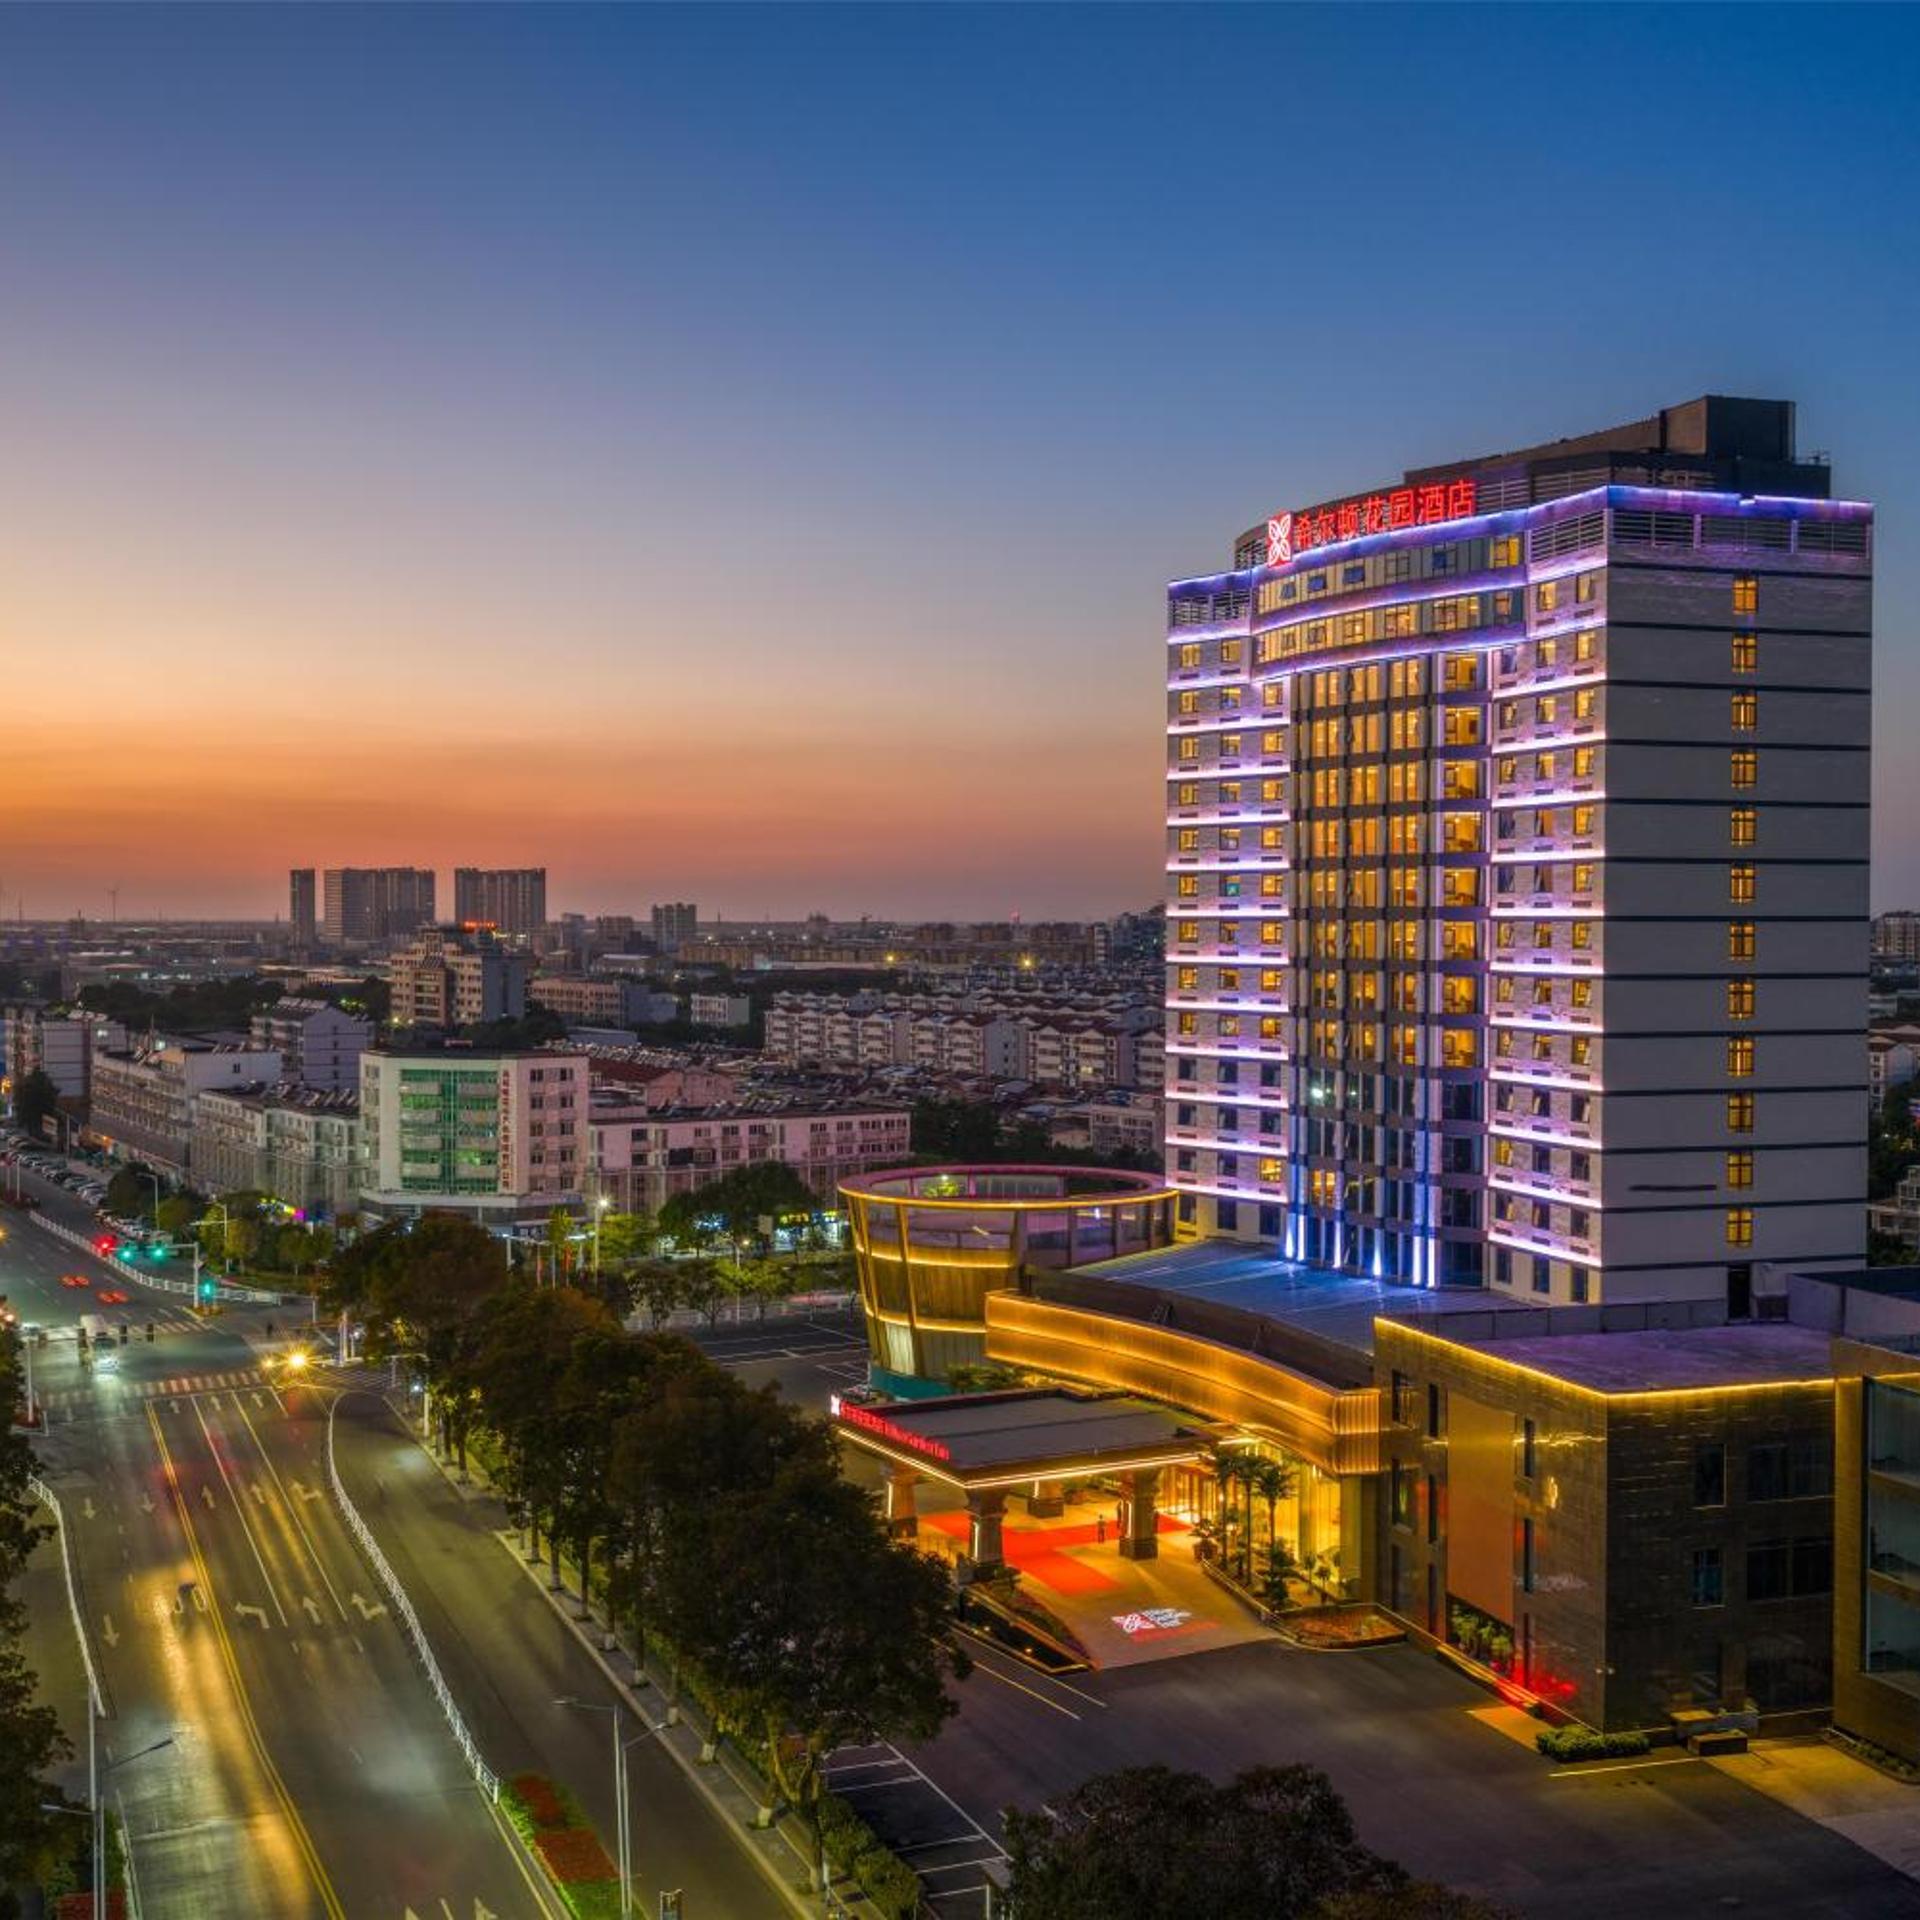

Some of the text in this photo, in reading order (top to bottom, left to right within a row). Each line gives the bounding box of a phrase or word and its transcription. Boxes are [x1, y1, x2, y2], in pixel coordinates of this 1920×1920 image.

[1297, 480, 1476, 547] 希尔顿花园酒店
